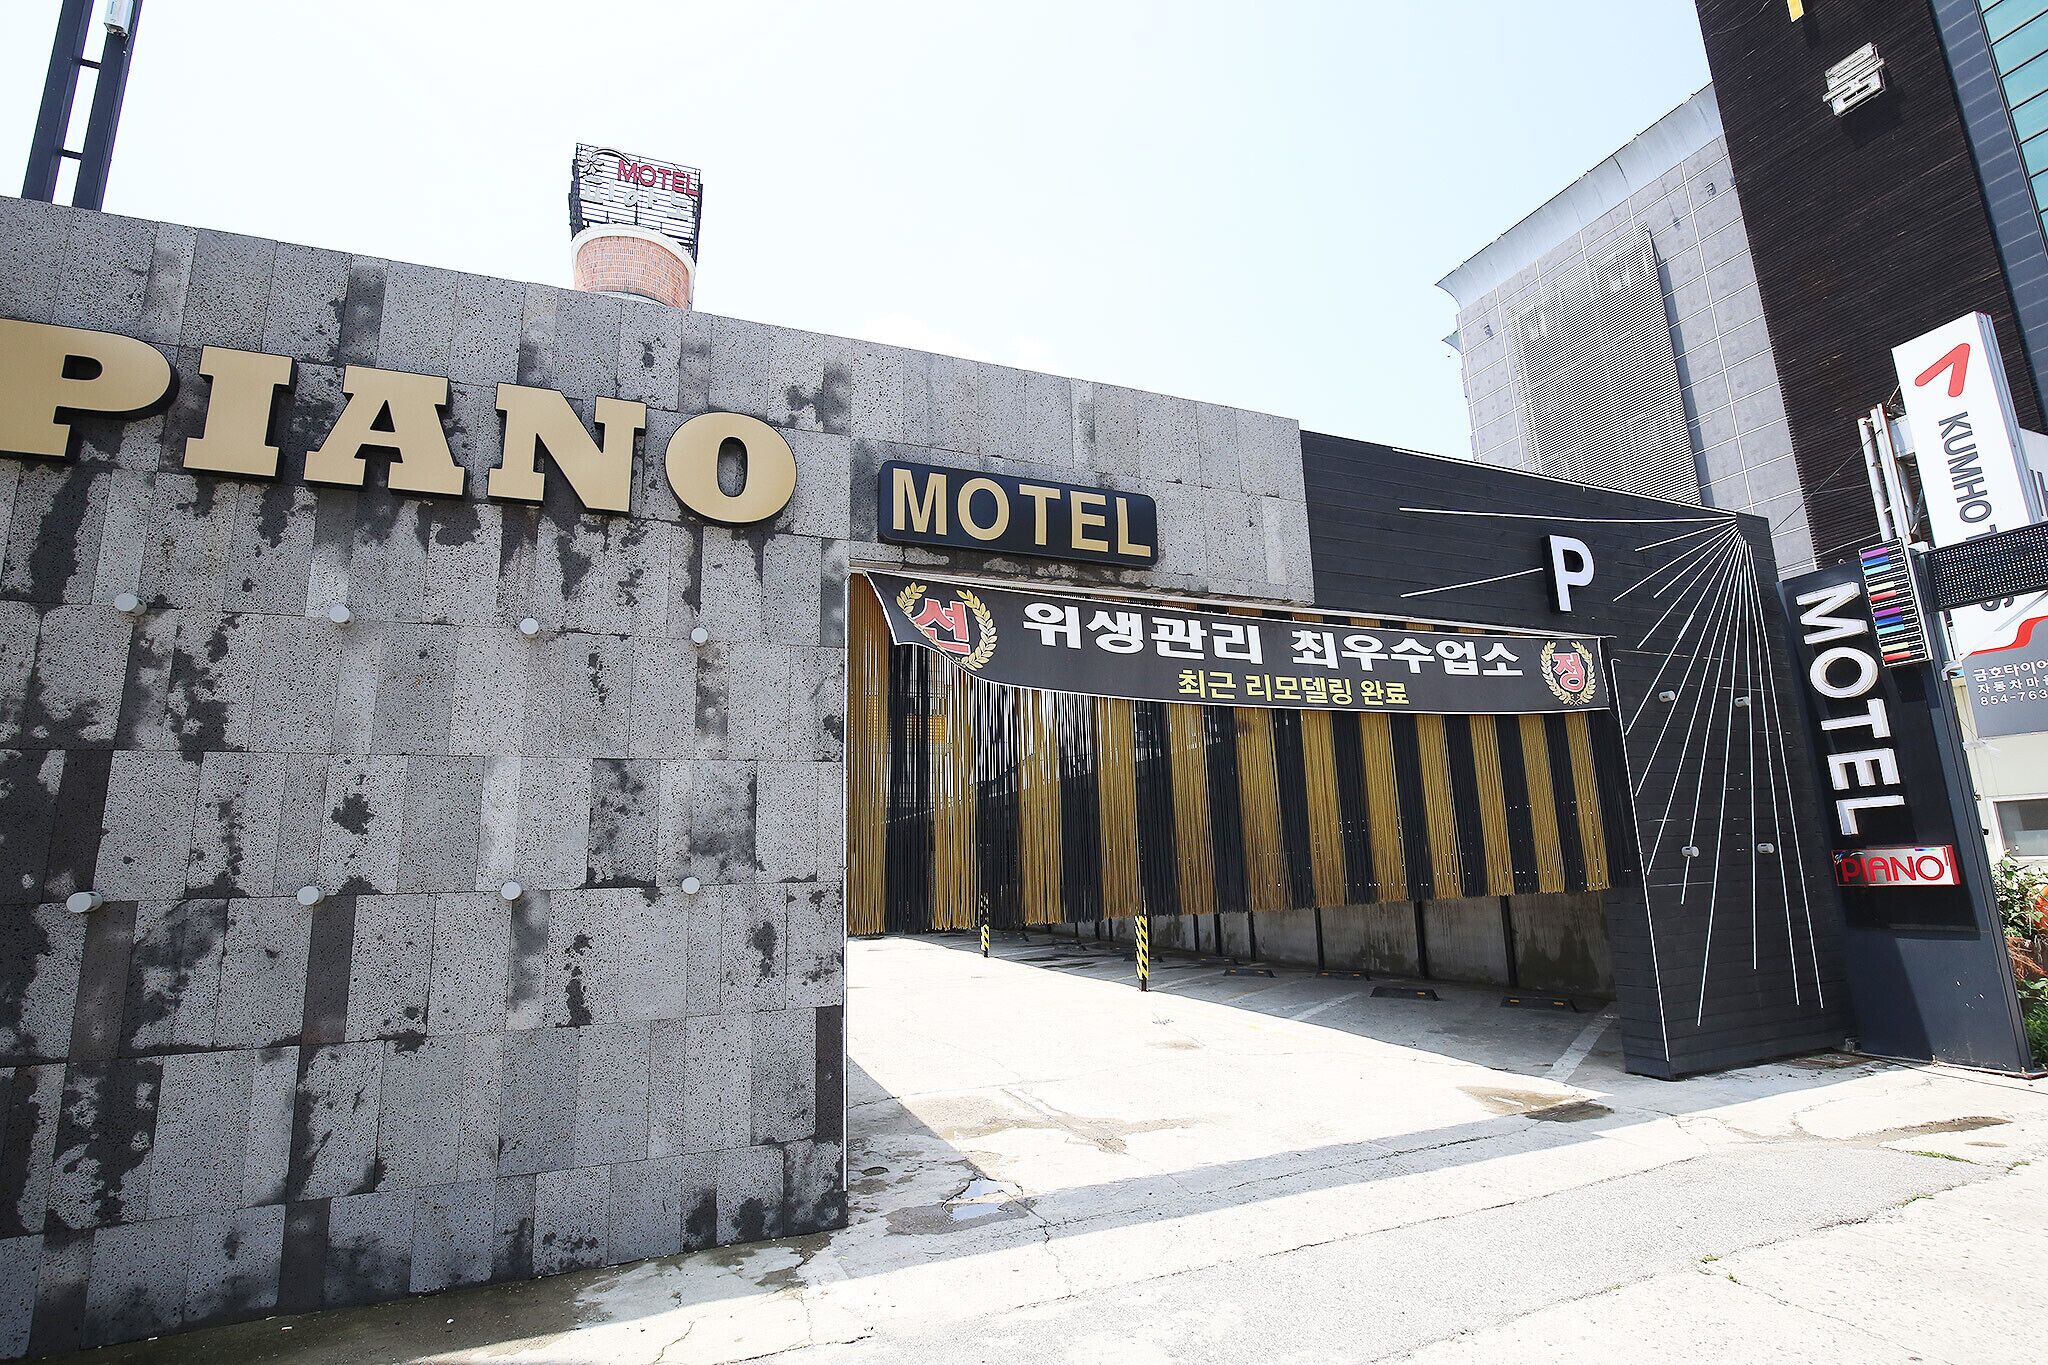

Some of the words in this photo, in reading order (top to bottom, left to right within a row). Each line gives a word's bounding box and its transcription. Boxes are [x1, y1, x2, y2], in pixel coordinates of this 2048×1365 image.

[617, 159, 699, 196] MOTEL
[0, 317, 797, 524] PIANO
[1938, 411, 1992, 523] KUMHO
[892, 467, 1151, 557] MOTEL
[1549, 534, 1595, 612] P
[914, 598, 971, 655] 선
[1023, 602, 1263, 665] 위생관리
[1291, 629, 1523, 677] 최우수업소
[1178, 669, 1237, 699] 최근
[1245, 674, 1352, 704] 리모델링
[1360, 680, 1409, 705] 완료
[1552, 652, 1587, 693] 정
[1796, 581, 1905, 835] MOTEL
[1841, 855, 1944, 881] PIANO
